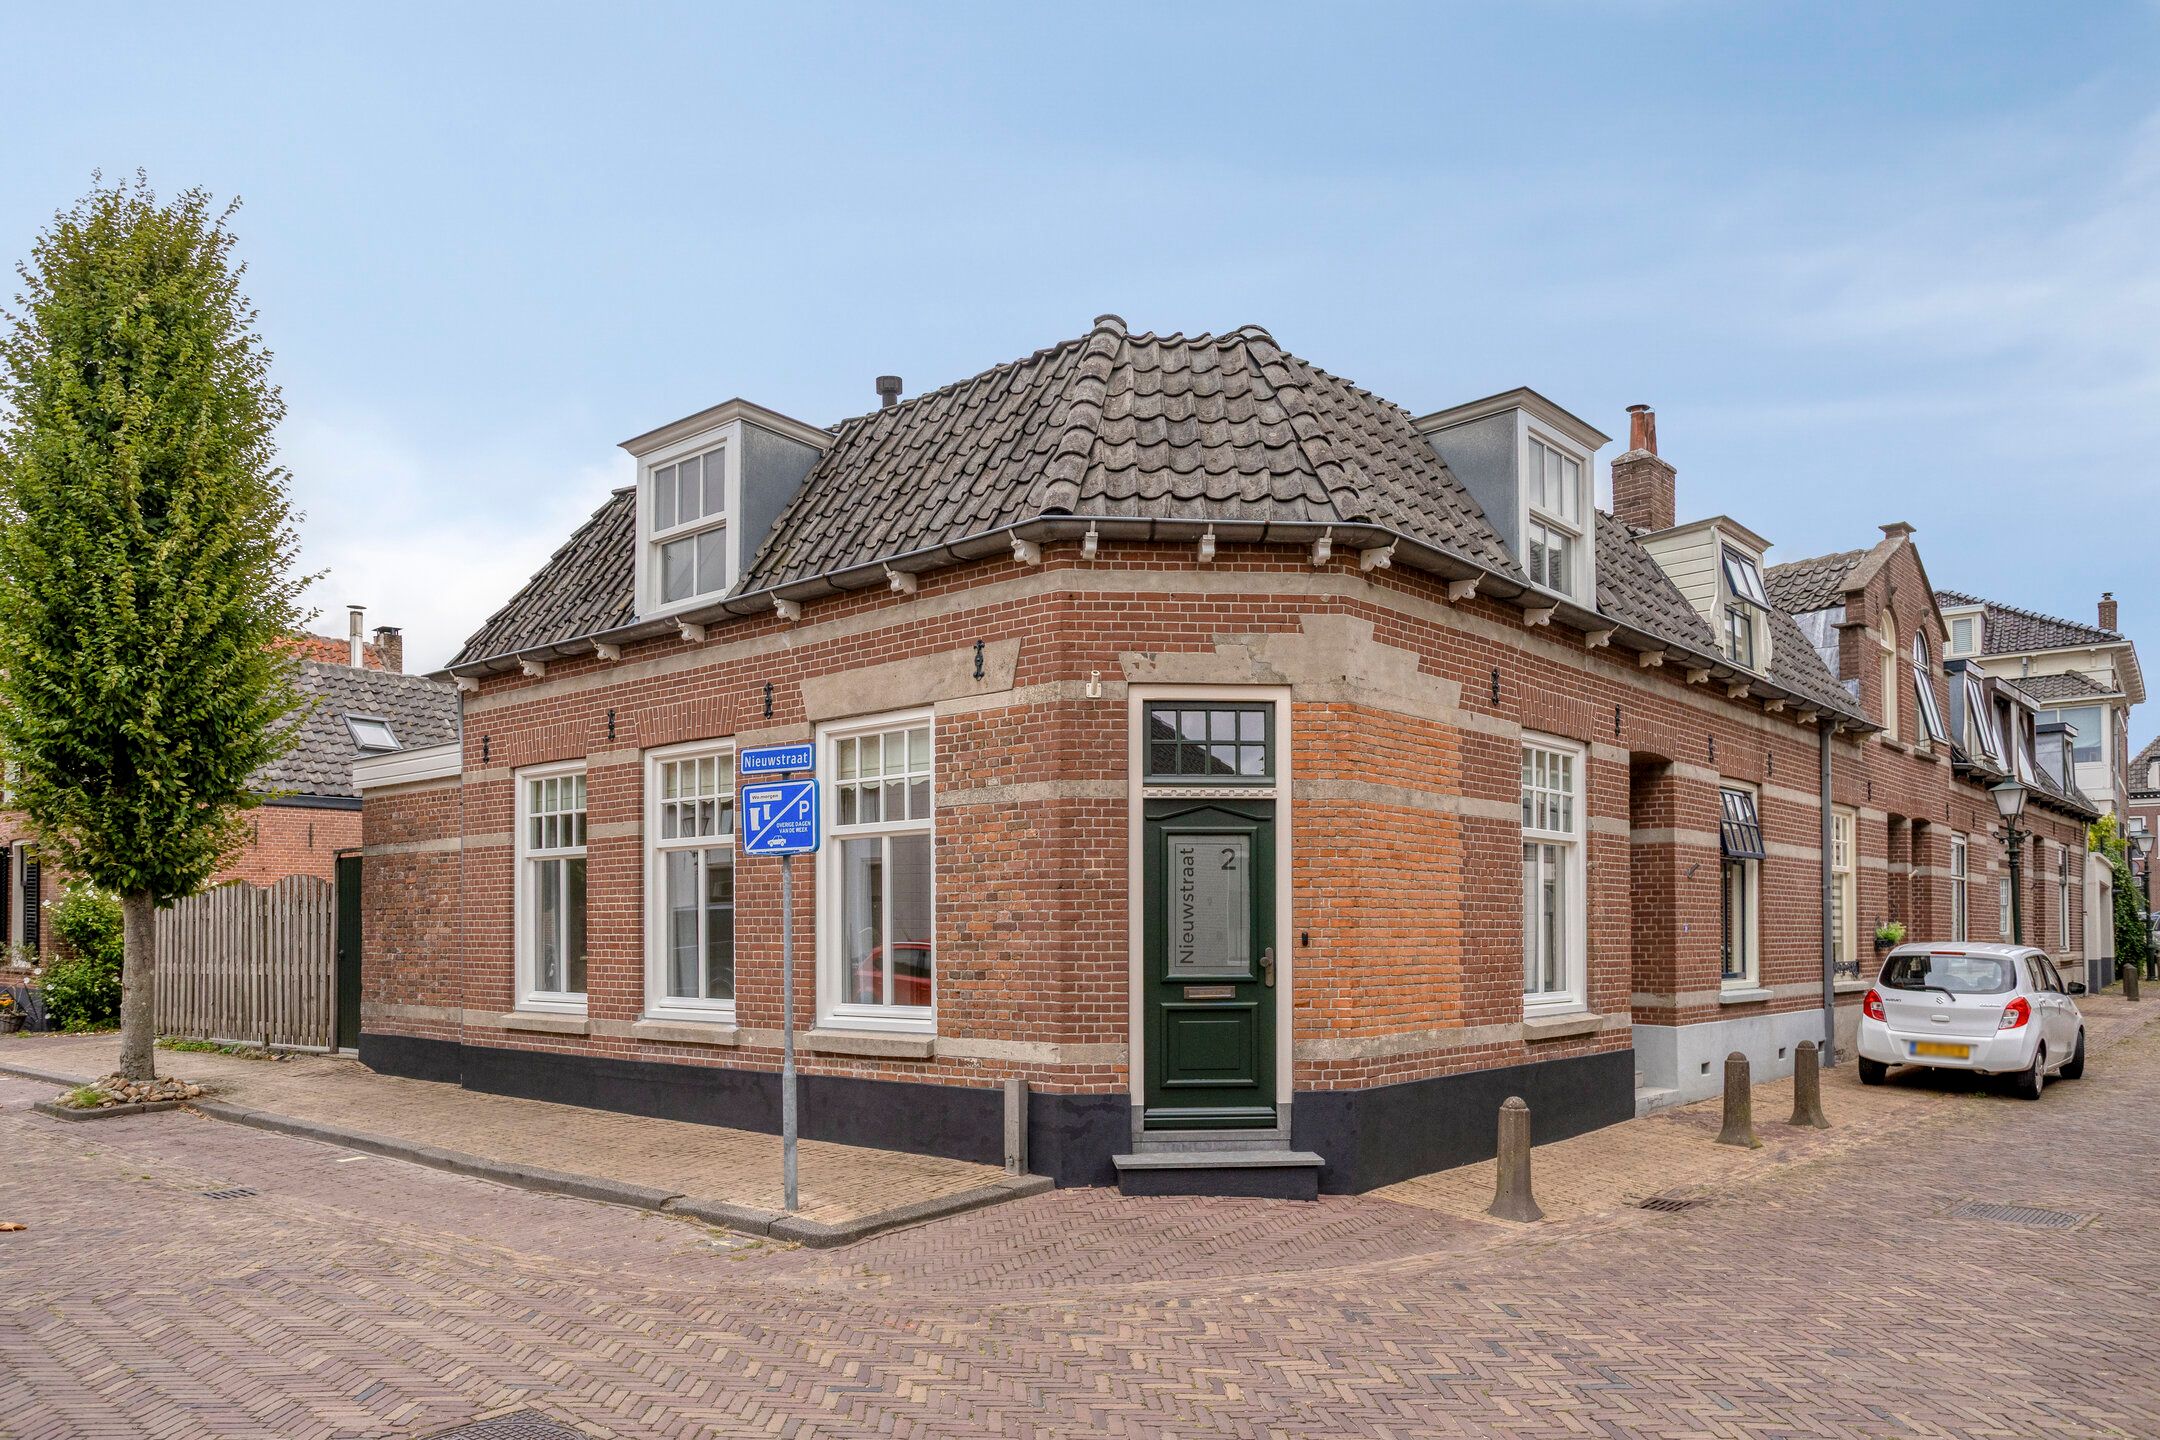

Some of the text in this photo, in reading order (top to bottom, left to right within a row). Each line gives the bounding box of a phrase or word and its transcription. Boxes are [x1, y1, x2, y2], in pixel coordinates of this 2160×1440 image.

[744, 752, 808, 768] Nieuwstraat
[799, 800, 810, 820] P
[1221, 848, 1236, 871] 2
[1179, 847, 1194, 964] Nieuwstraat
